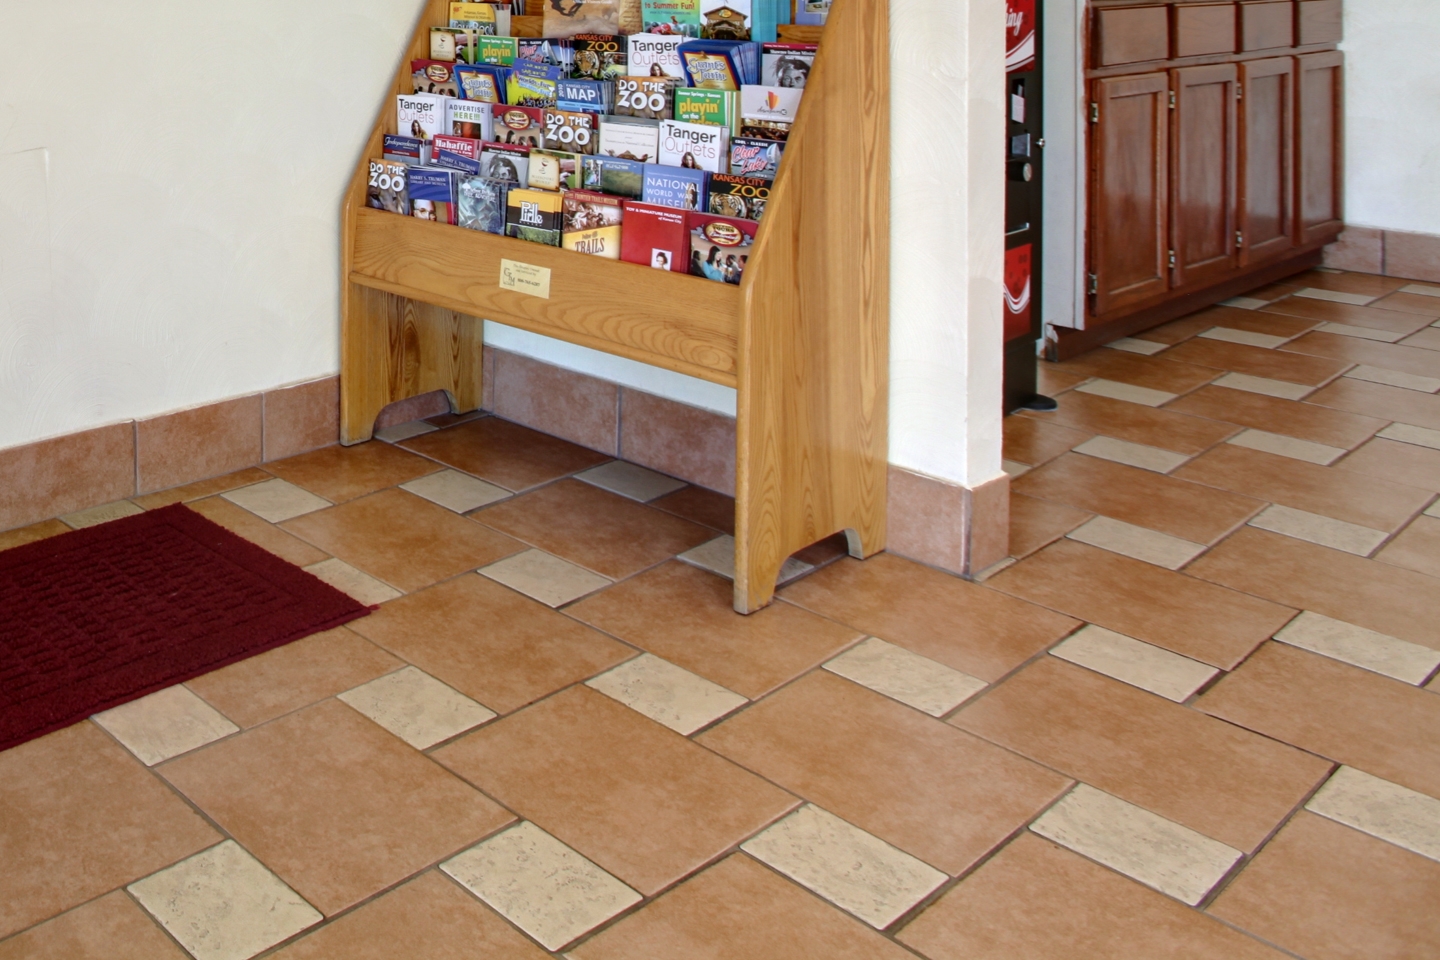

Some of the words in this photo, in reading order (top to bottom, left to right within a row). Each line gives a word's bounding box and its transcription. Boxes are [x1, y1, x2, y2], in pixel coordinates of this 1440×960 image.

[587, 41, 618, 52] ZOO
[631, 40, 679, 54] Tanger
[632, 52, 680, 65] Outlets
[619, 80, 638, 91] DO
[642, 81, 665, 93] THE
[566, 88, 596, 101] MAP
[617, 90, 665, 111] ZOO
[399, 99, 434, 113] Tanger
[449, 104, 485, 114] ADVERTISE
[679, 98, 719, 115] playin'
[399, 109, 435, 124] Outlets
[546, 114, 564, 124] DO
[569, 116, 590, 127] THE
[546, 124, 590, 145] ZOO
[666, 124, 716, 144] Tanger
[384, 137, 418, 148] Independence
[664, 137, 716, 159] Outlets
[732, 145, 760, 162] Clear
[370, 162, 384, 173] DO
[387, 165, 405, 176] THE
[459, 161, 476, 171] TRUMAN
[741, 157, 768, 175] Lake
[369, 172, 405, 192] ZOO
[646, 177, 700, 193] NATIONAL
[713, 174, 745, 185] KANSAS
[746, 178, 765, 187] CITY
[646, 188, 674, 197] WORLD
[677, 192, 693, 200] WAR
[730, 184, 771, 199] ZOO
[646, 197, 699, 211] MUSEUM
[575, 237, 605, 254] TRAILS
